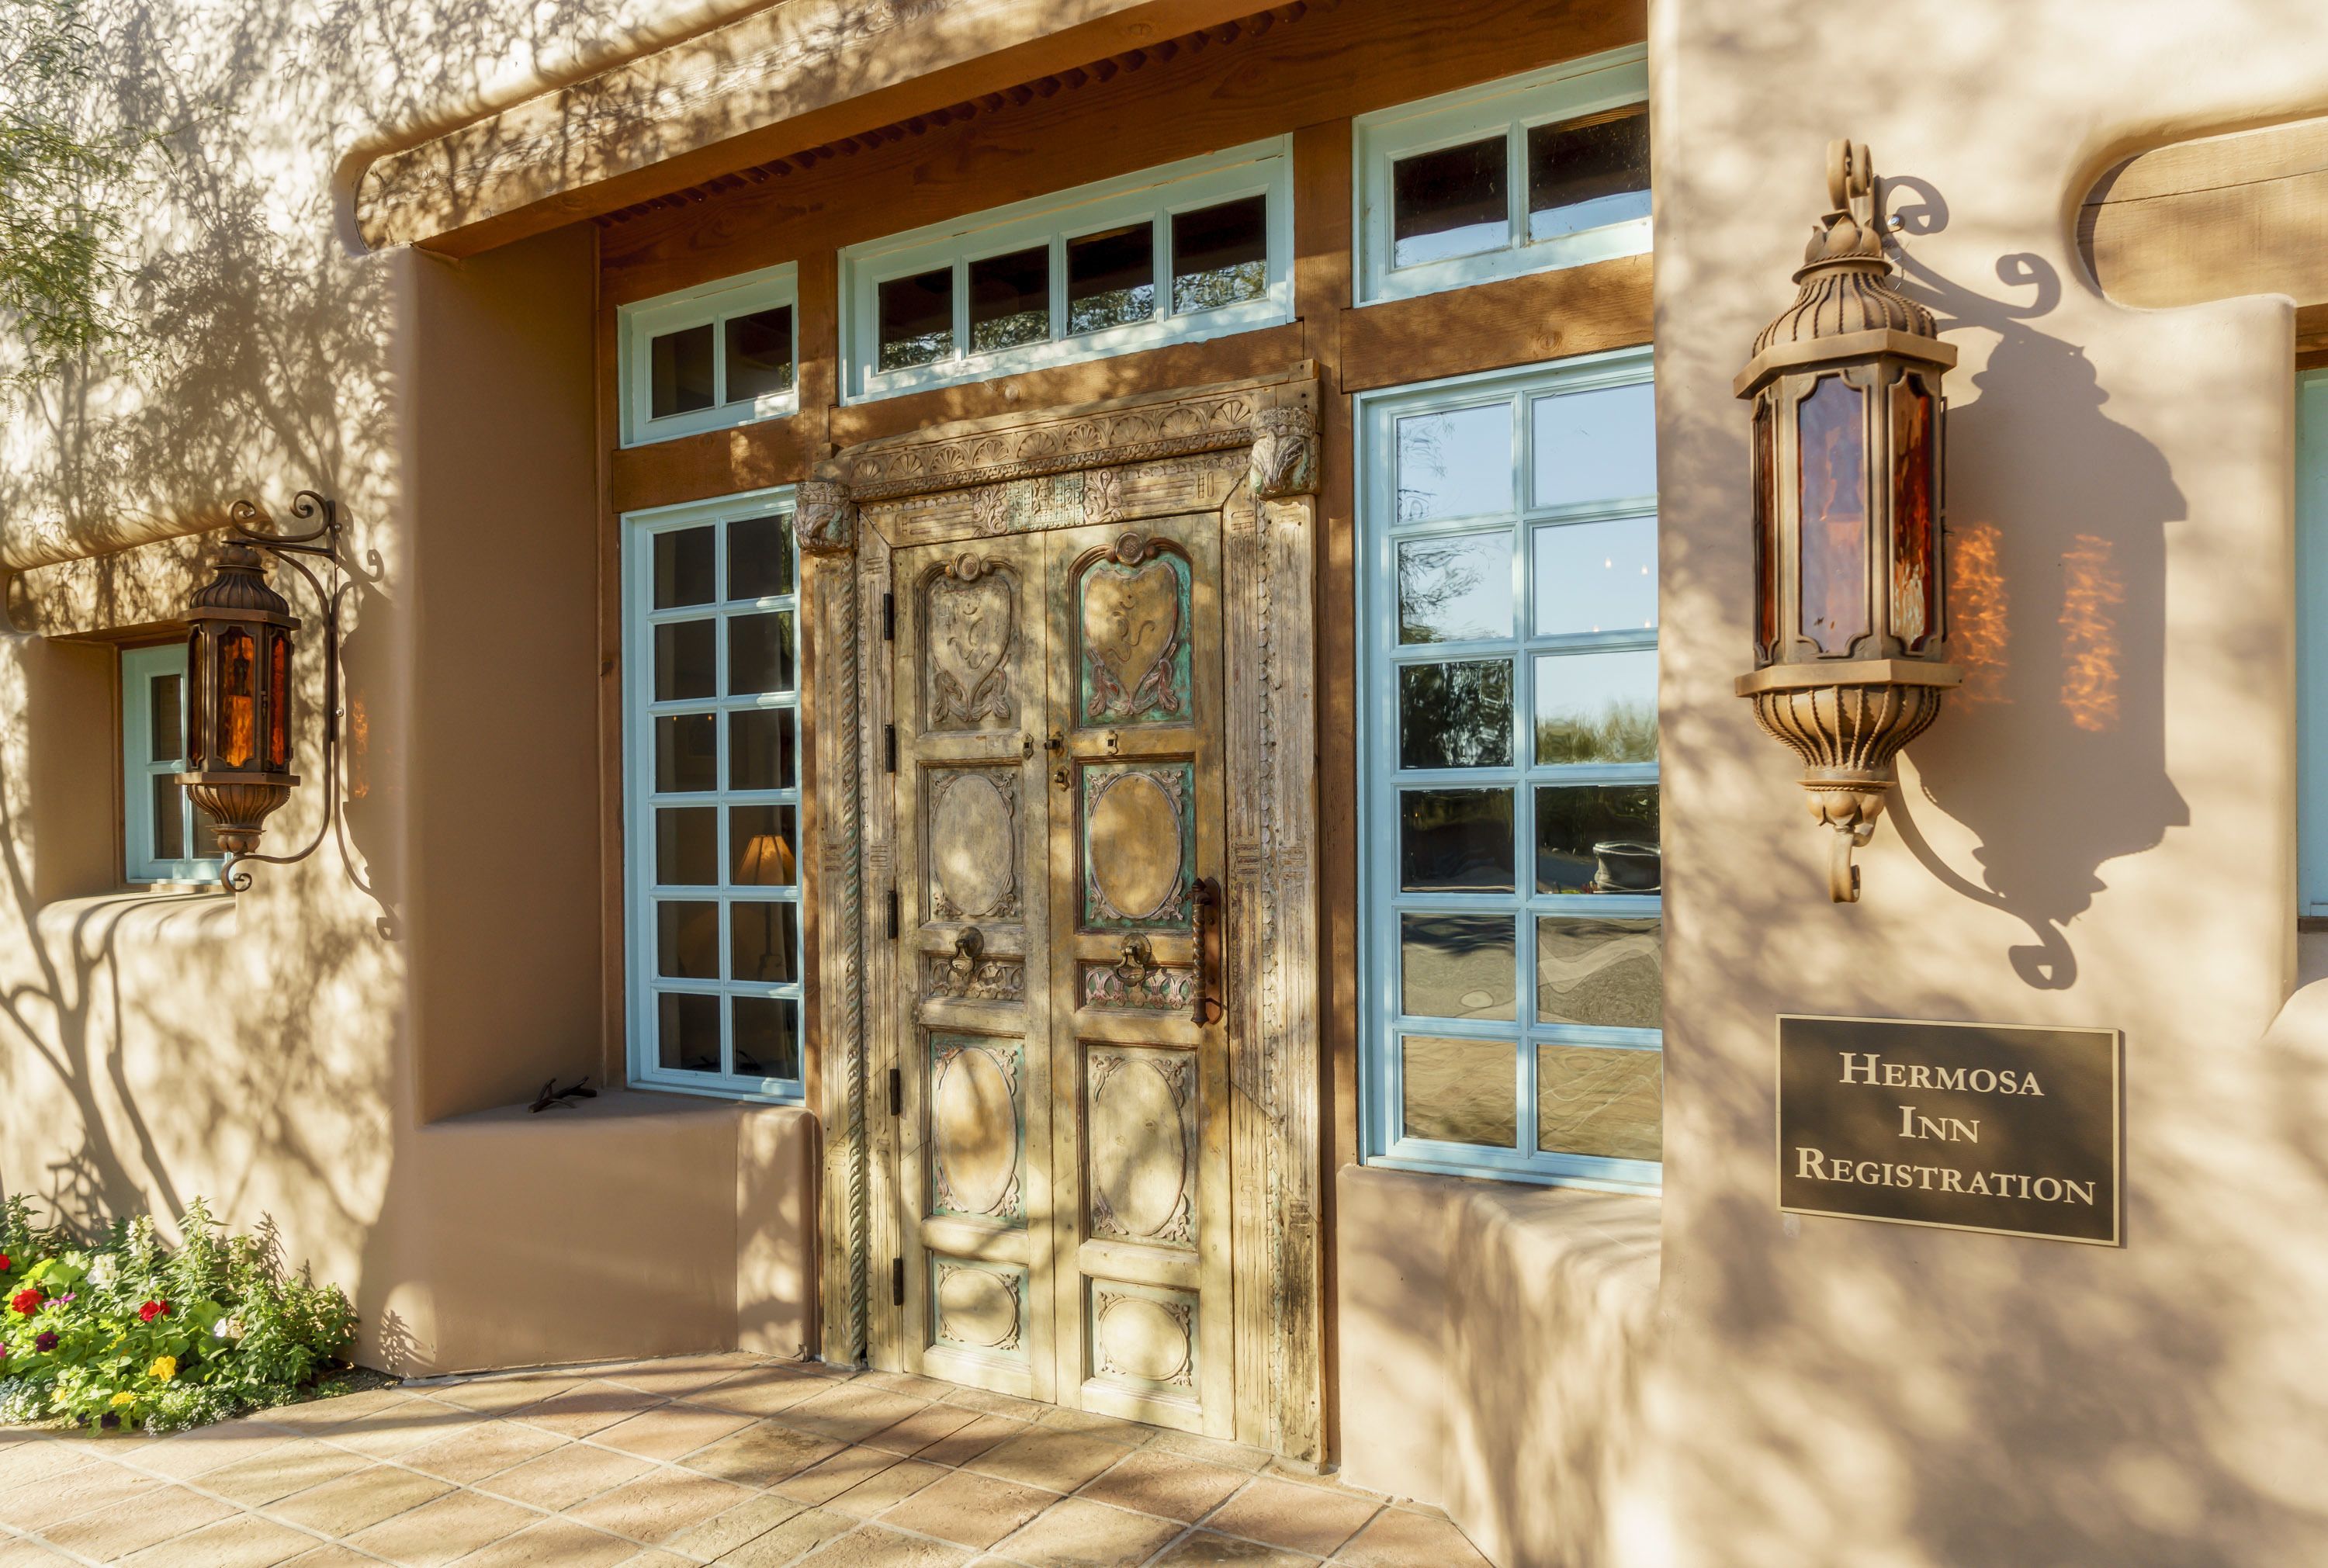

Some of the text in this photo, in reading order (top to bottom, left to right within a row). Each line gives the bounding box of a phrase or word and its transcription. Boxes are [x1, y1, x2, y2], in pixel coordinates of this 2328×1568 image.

[1839, 1052, 2045, 1096] HERMOSA
[1898, 1106, 1980, 1144] INN
[1795, 1147, 2096, 1206] REGISTRATION
